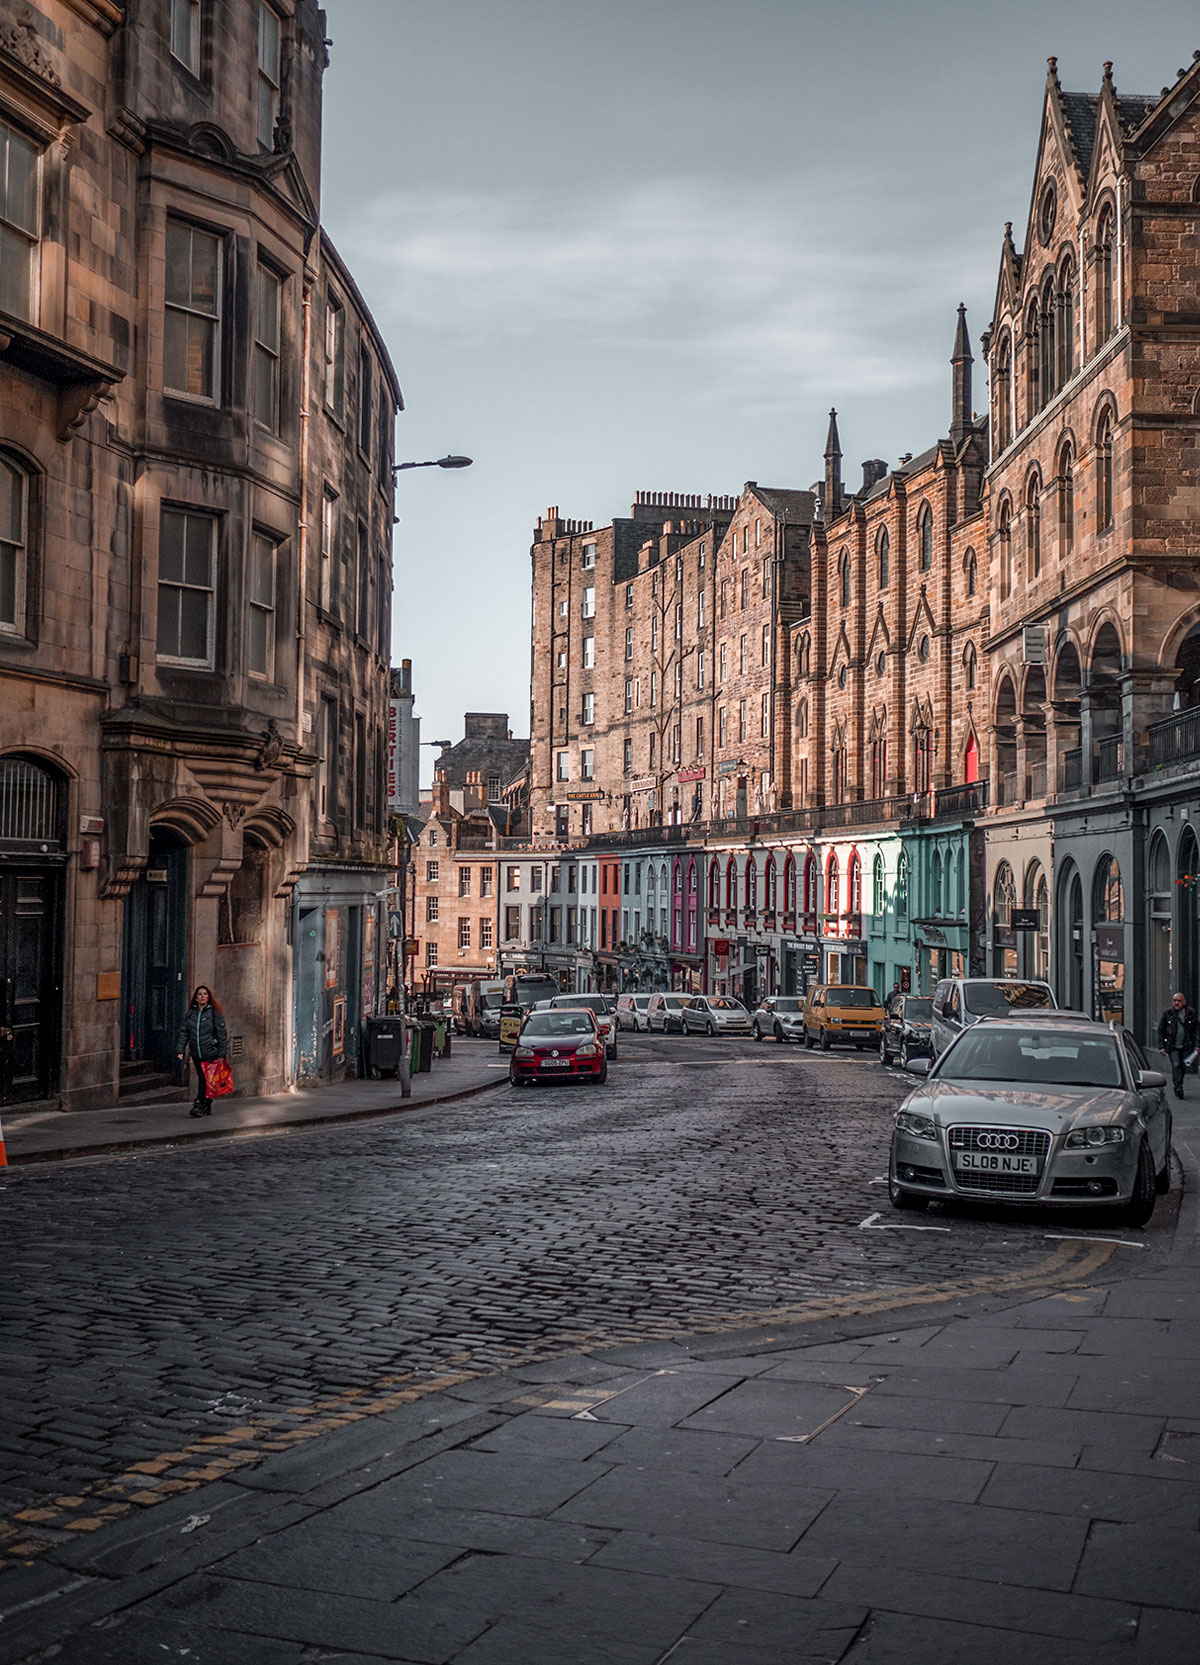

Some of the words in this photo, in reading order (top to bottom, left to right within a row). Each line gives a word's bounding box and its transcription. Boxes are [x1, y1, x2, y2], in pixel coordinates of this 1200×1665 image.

[387, 706, 397, 797] BERTIES
[786, 941, 794, 949] THE
[805, 943, 814, 951] SHOP
[962, 1154, 998, 1170] SL08
[1002, 1157, 1030, 1172] NJE
